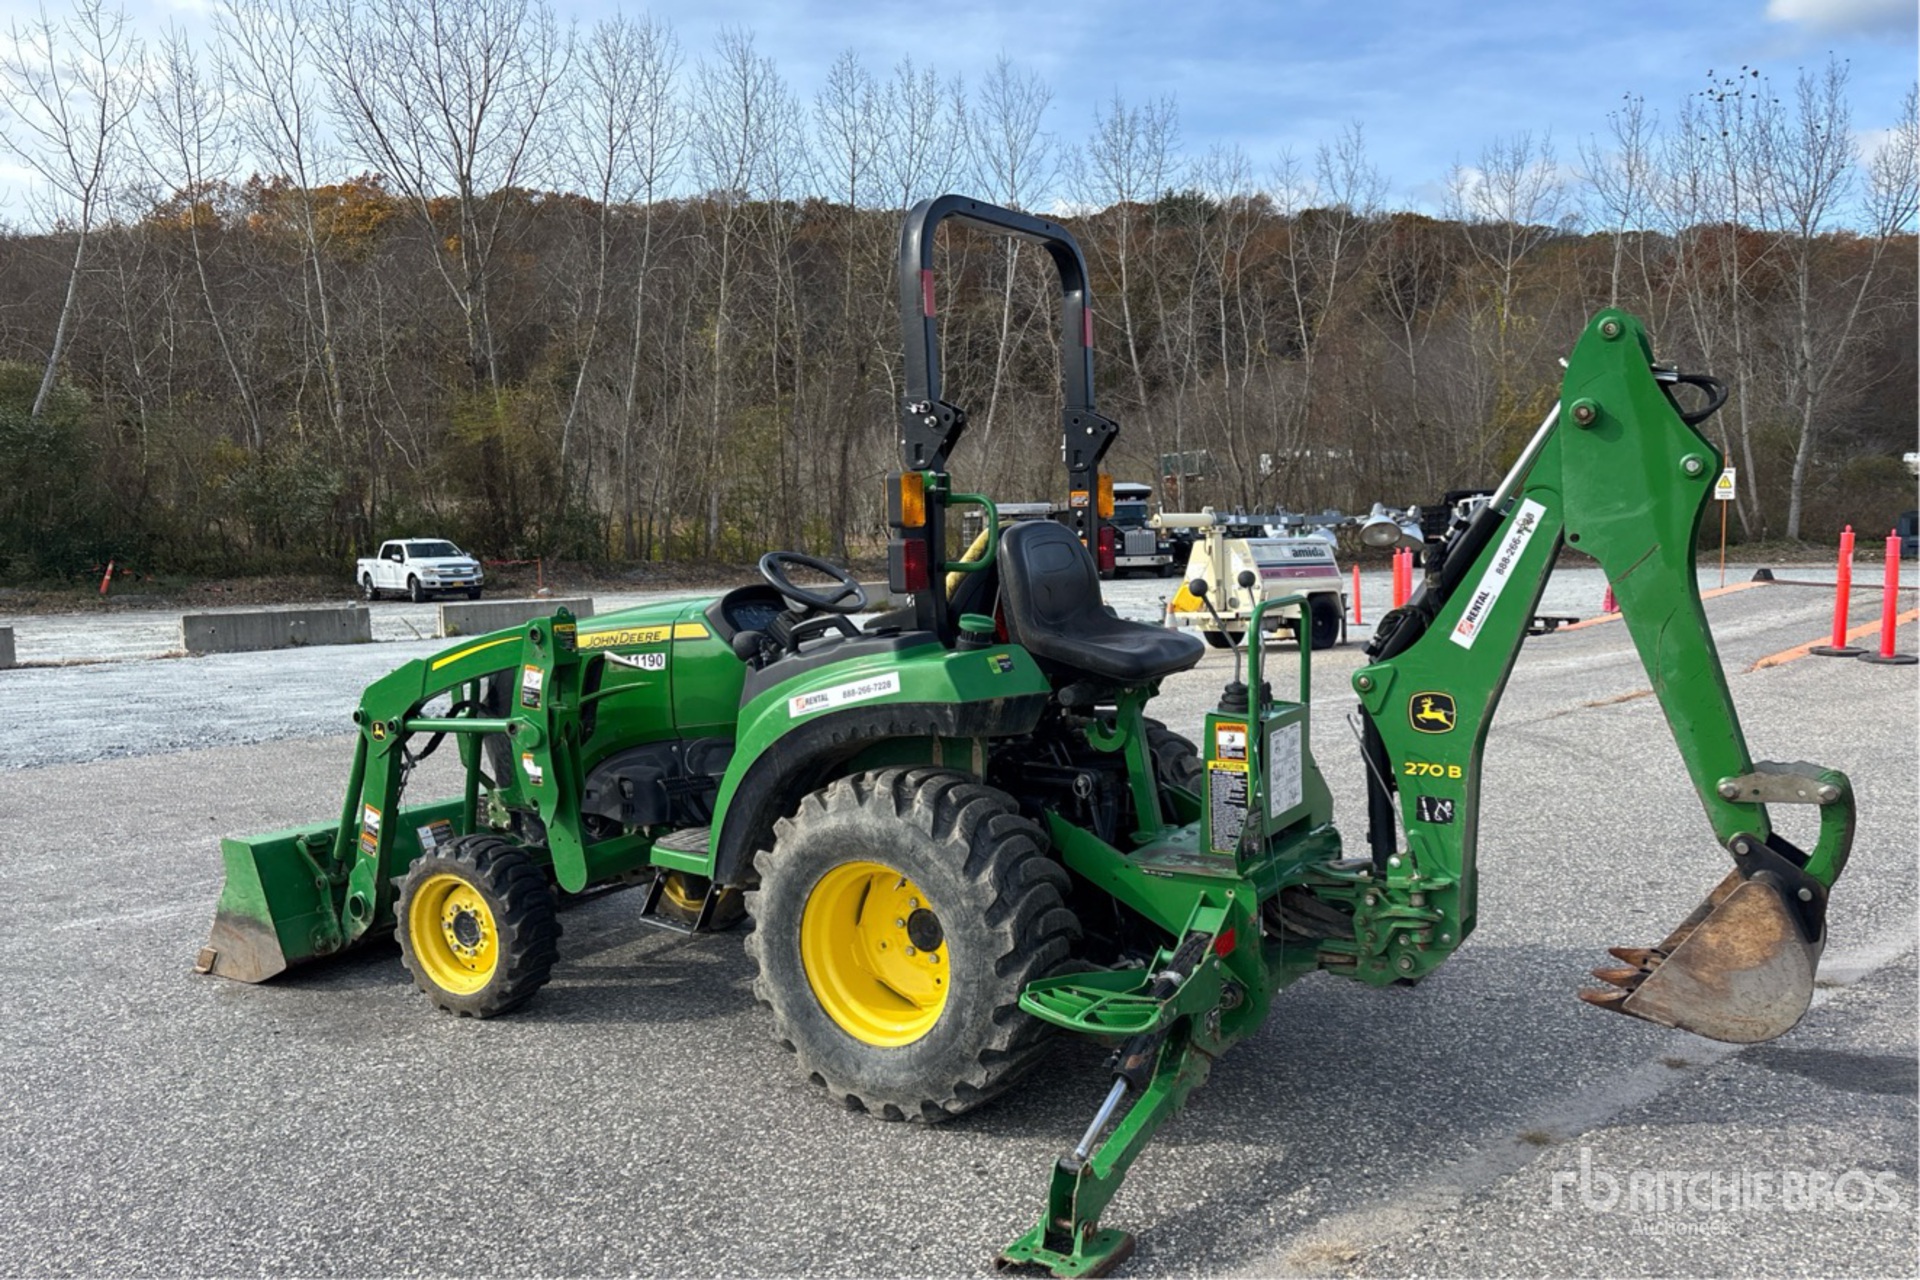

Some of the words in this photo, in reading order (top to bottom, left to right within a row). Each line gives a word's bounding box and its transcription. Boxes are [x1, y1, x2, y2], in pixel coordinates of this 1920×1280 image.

[1291, 547, 1326, 558] amida
[1466, 591, 1490, 623] RENTAL
[586, 635, 619, 648] JOHN
[619, 631, 662, 644] DEERE
[805, 693, 829, 706] RENTAL
[1404, 762, 1445, 777] 270
[1448, 765, 1462, 778] B
